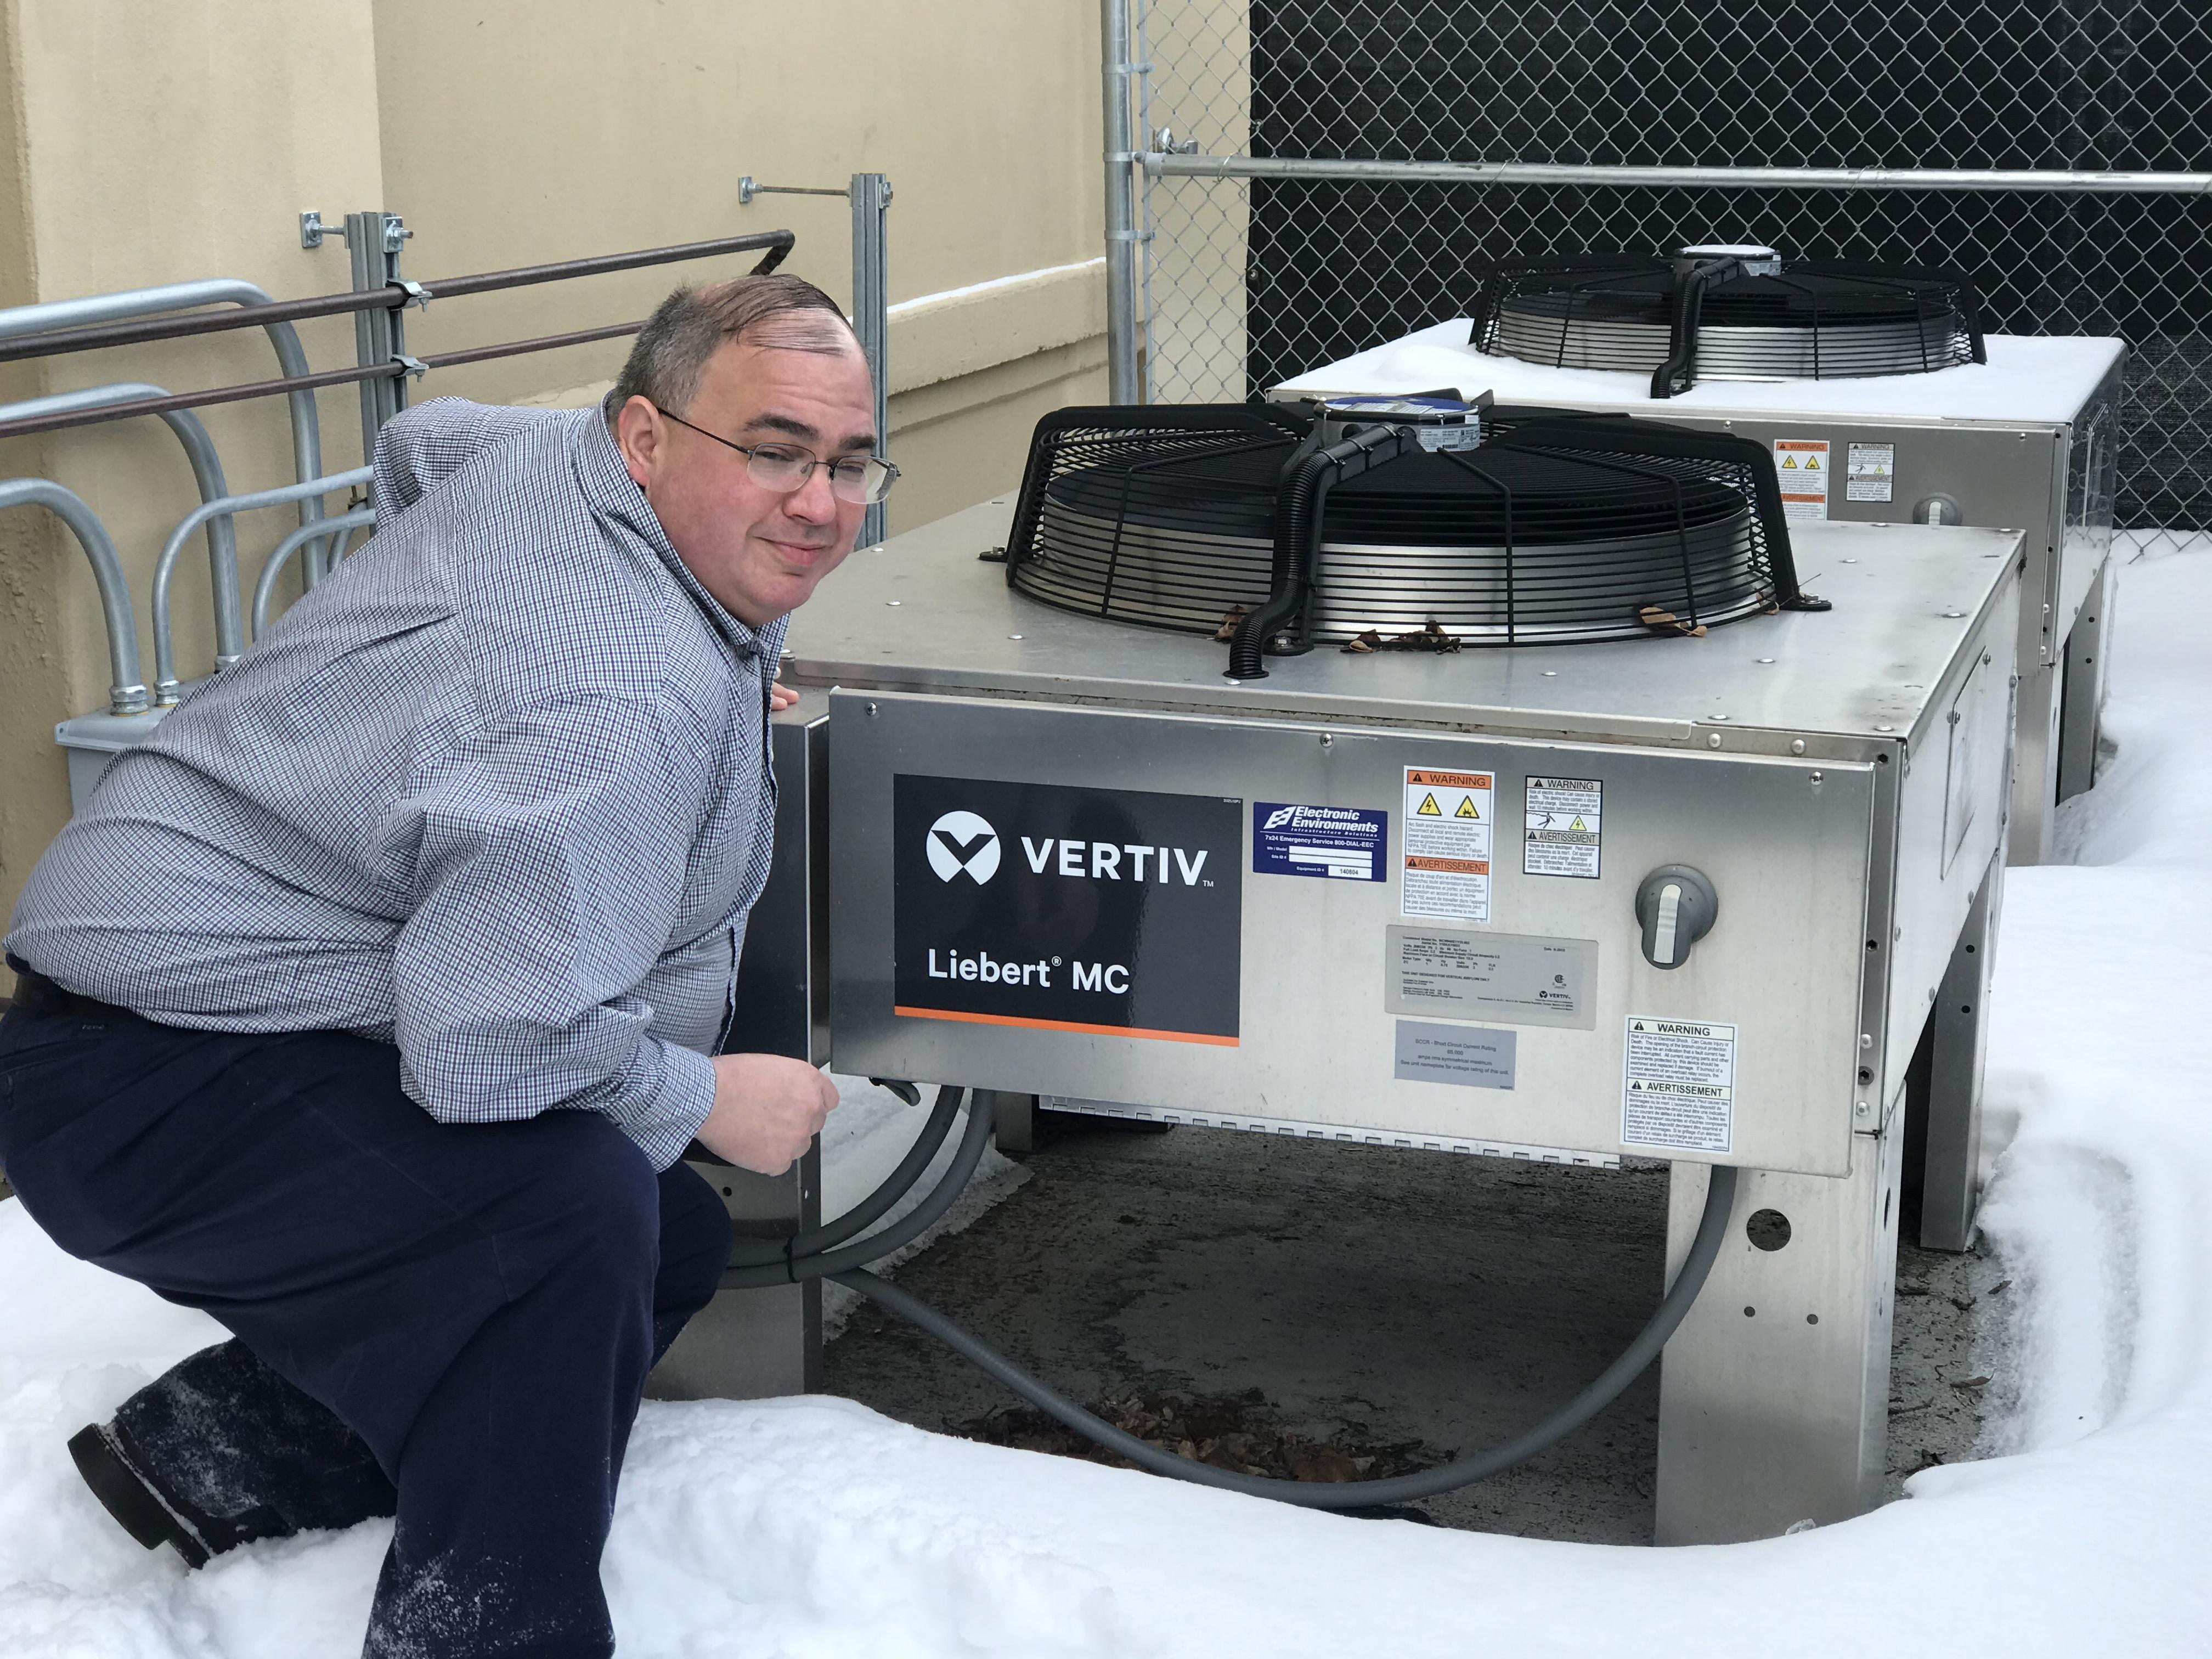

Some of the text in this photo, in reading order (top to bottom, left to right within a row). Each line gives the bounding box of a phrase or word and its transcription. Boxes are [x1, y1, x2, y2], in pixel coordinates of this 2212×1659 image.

[1429, 774, 1485, 786] WARNING
[1547, 779, 1593, 790] WARNING
[1295, 805, 1359, 820] Electronic
[1291, 816, 1378, 832] Environments
[1279, 835, 1311, 844] Emergency
[1334, 839, 1374, 848] 800-DIAL-EEC
[1538, 831, 1596, 843] AVERTISSEMENT
[1417, 859, 1486, 872] AVERTISSEMENT
[1073, 961, 1128, 994] MC
[1657, 1023, 1709, 1036] WARNING
[1646, 1082, 1723, 1097] AVERTISSEMENT
